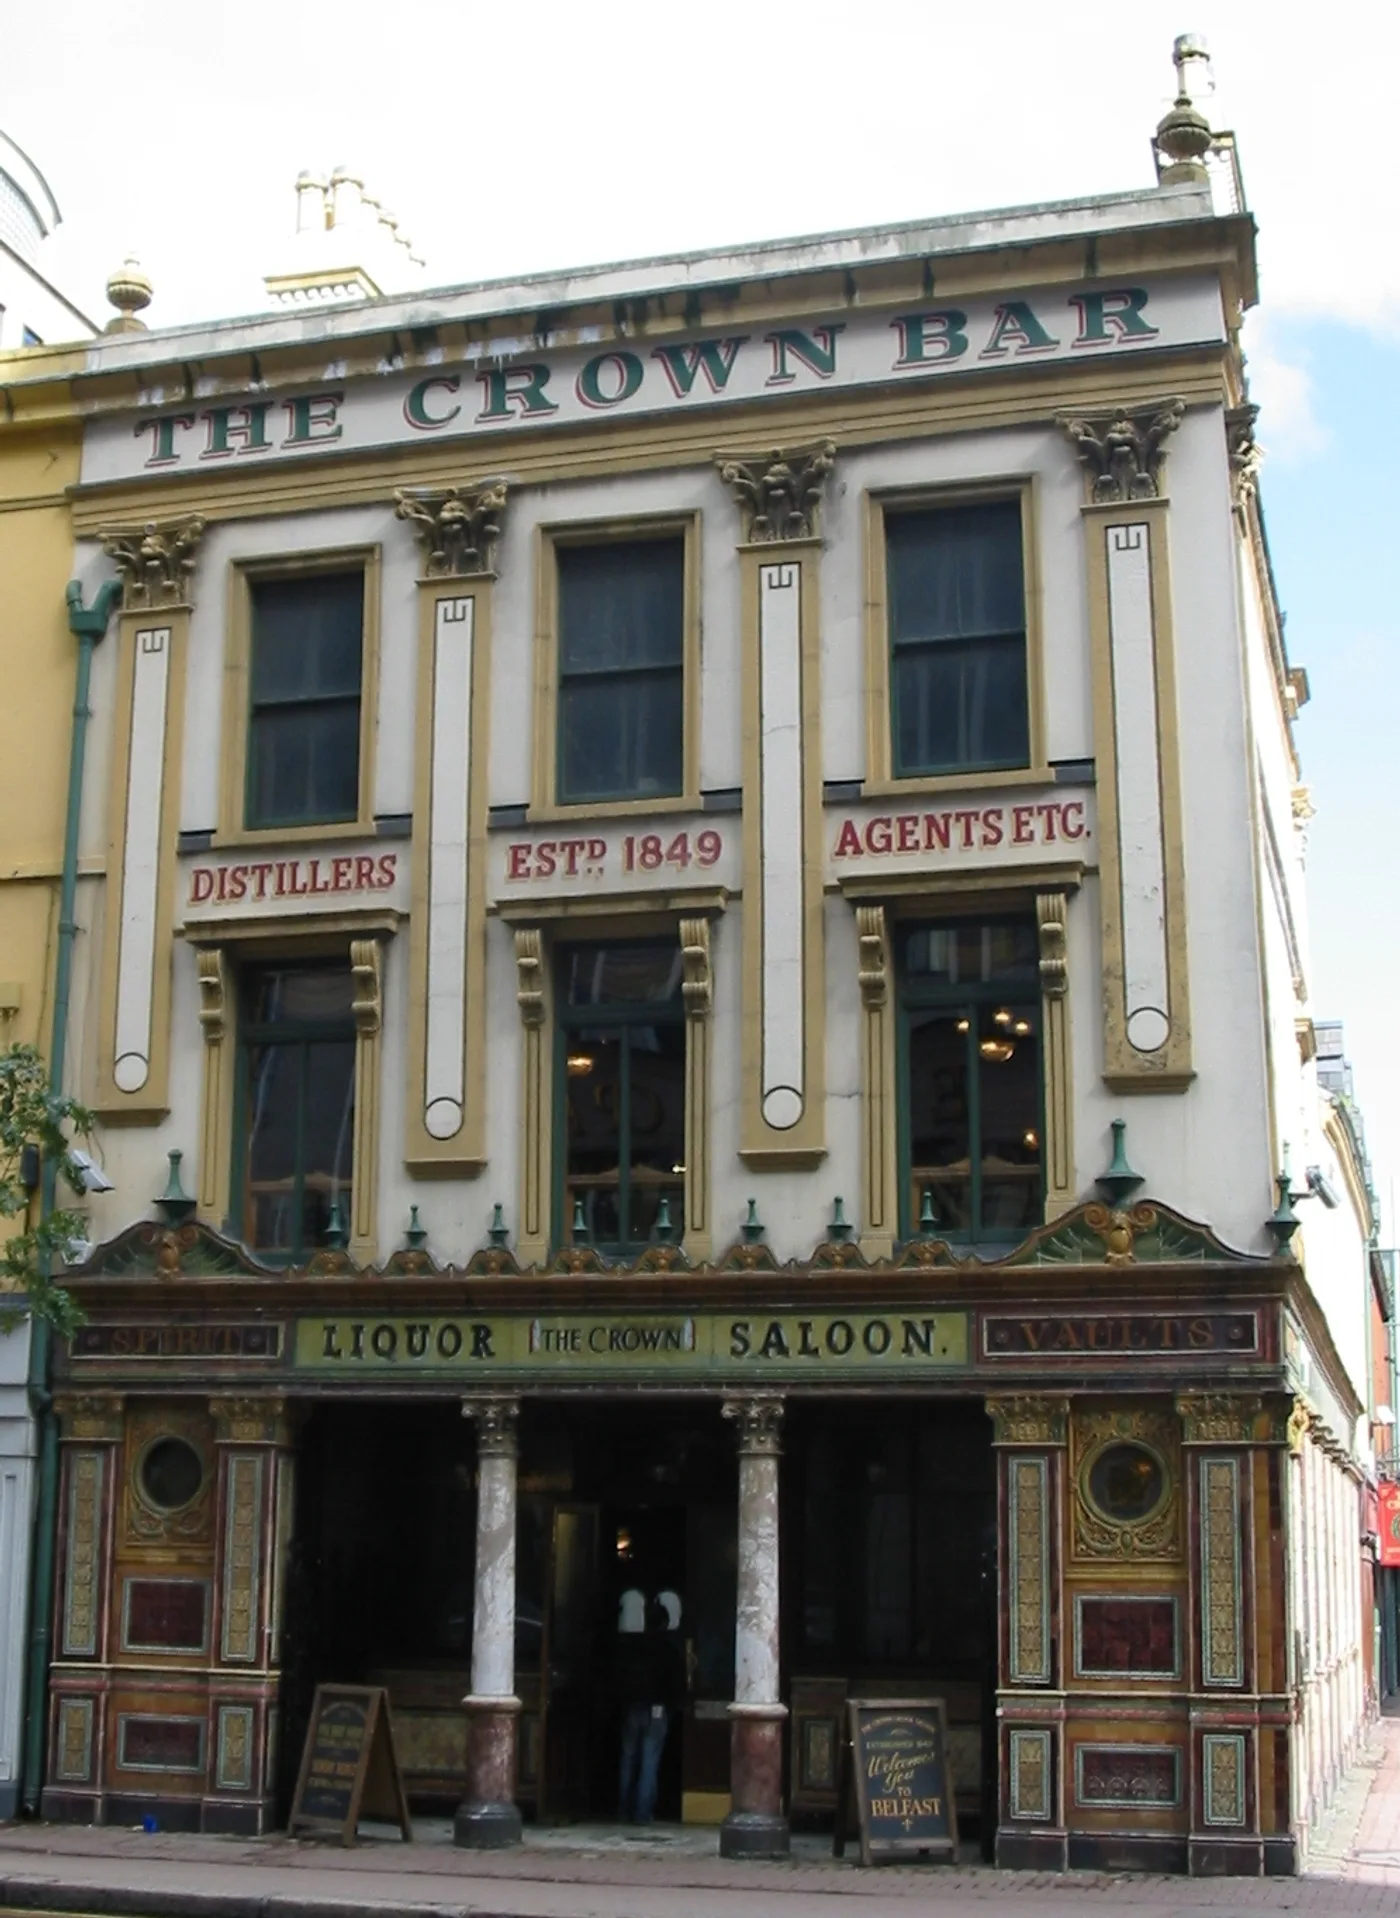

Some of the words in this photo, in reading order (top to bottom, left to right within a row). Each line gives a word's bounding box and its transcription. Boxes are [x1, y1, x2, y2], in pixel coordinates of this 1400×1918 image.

[133, 391, 344, 467] THE
[402, 322, 846, 430] CROWN
[891, 286, 1158, 371] BAR
[832, 807, 1003, 860] AGENTS
[1012, 801, 1092, 846] ETC.
[623, 829, 723, 874] 1849
[186, 853, 398, 907] DISTILLERS
[111, 1326, 240, 1354] SPIRIT
[322, 1323, 496, 1363] LIQUOR
[541, 1327, 582, 1353] THE
[589, 1326, 682, 1354] CROWN
[1020, 1318, 1214, 1351] VAULTS
[871, 1798, 941, 1817] BELFAST
